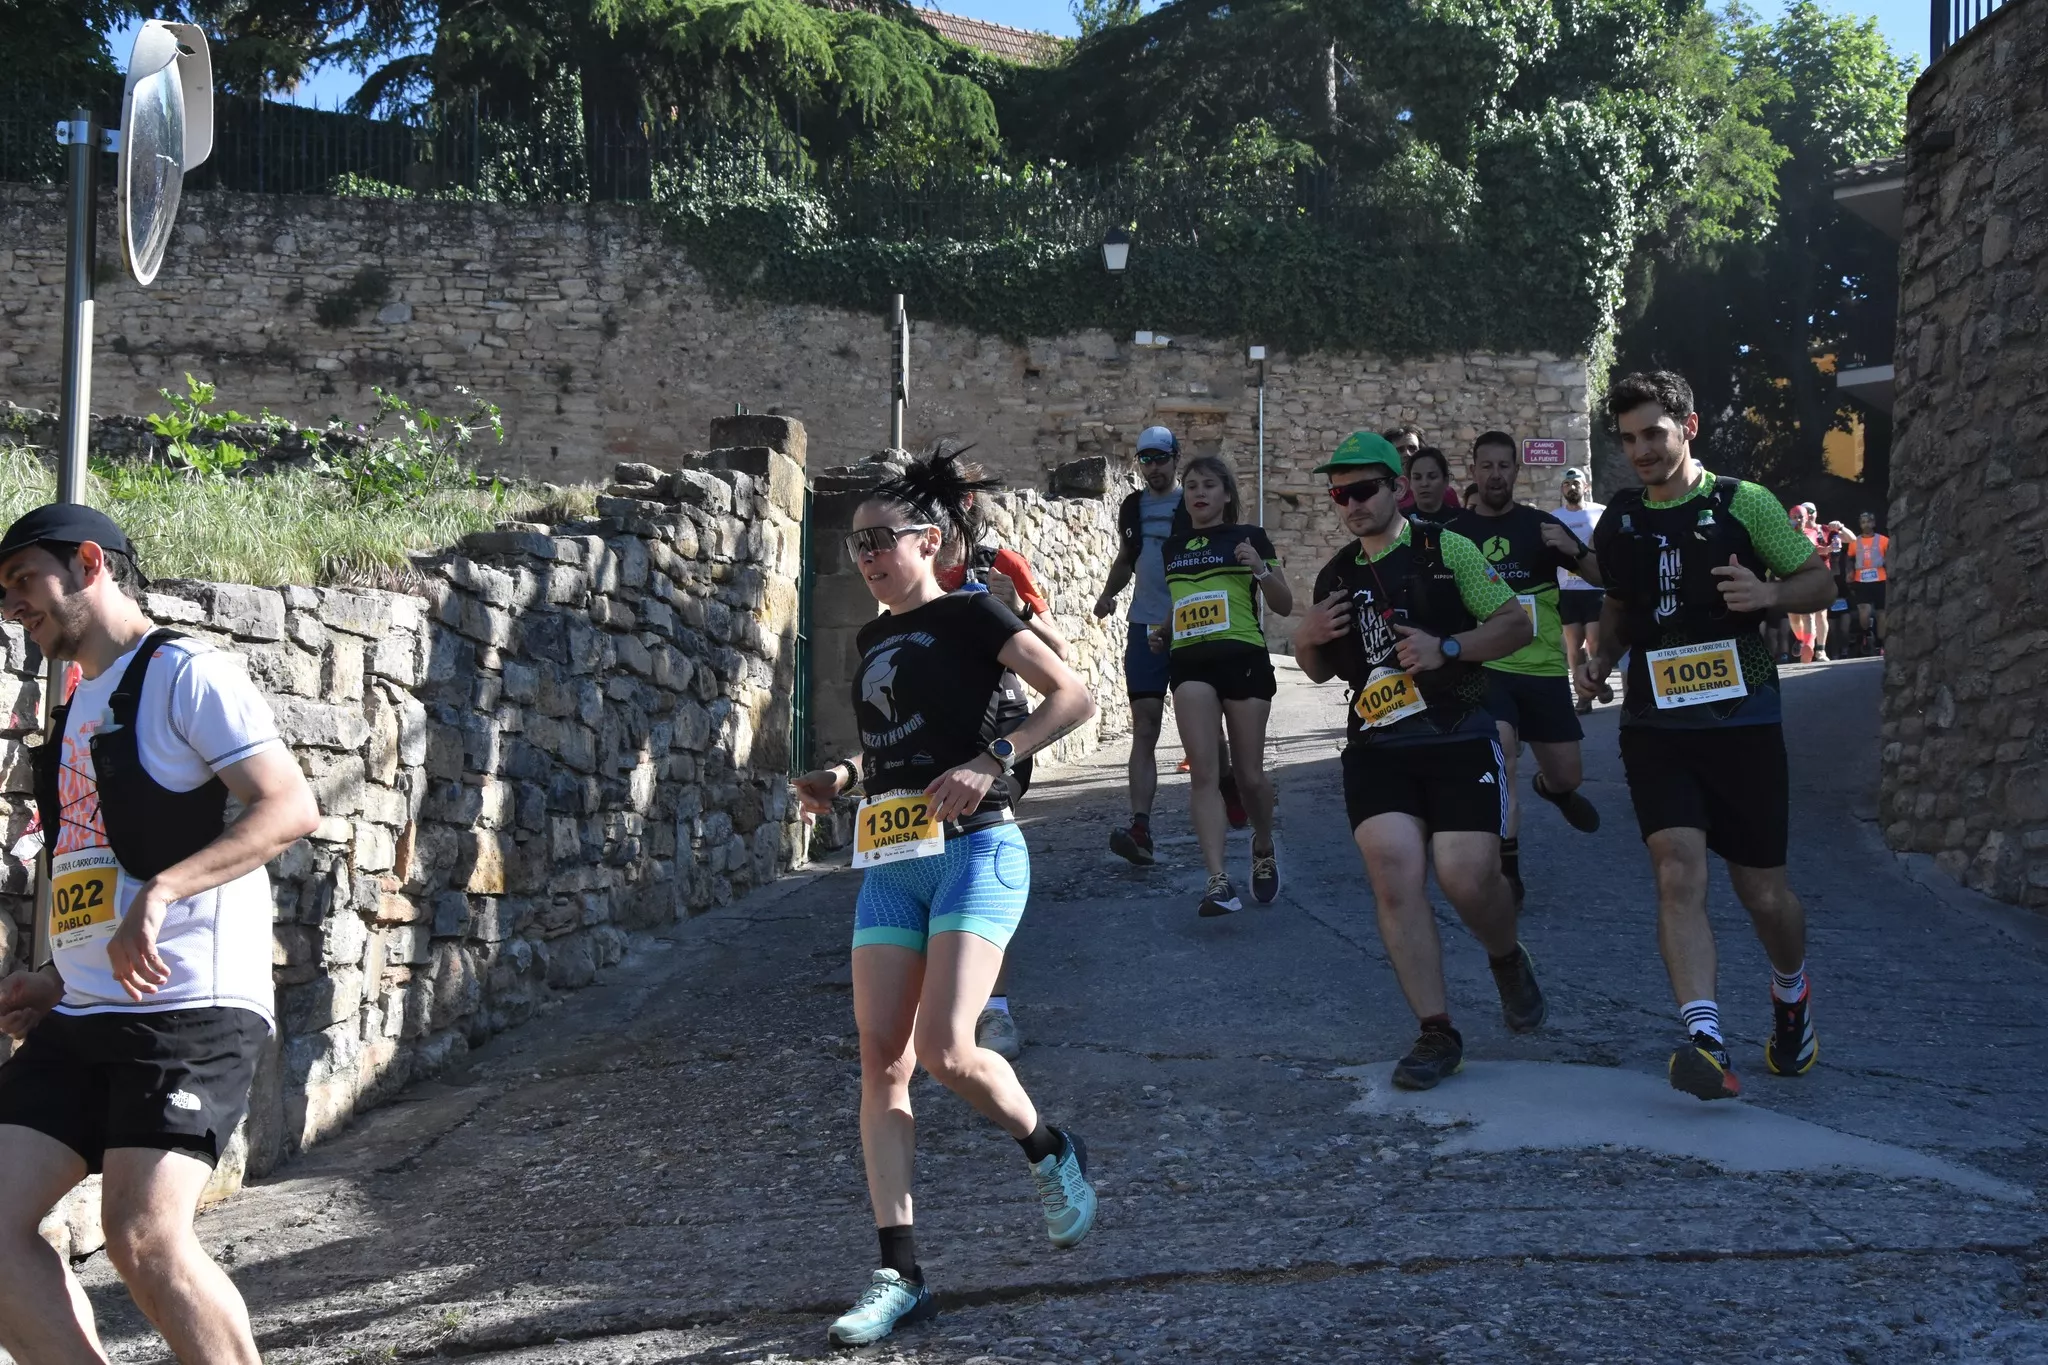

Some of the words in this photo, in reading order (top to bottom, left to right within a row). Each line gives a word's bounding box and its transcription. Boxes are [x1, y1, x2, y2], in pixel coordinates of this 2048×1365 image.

[1183, 551, 1201, 560] RETO
[1202, 549, 1212, 557] DE
[1166, 556, 1224, 571] CORRER.COM
[1508, 562, 1520, 570] DE
[1180, 604, 1219, 623] 1101
[1186, 619, 1214, 629] ESTELA
[1679, 646, 1697, 655] SIERRA
[1698, 641, 1730, 652] CARRODILLA
[1663, 658, 1728, 684] 1005
[1361, 679, 1407, 713] 1004
[1665, 679, 1732, 696] GUILLERMO
[866, 803, 928, 836] 1302
[873, 831, 919, 848] VANESA
[72, 856, 116, 868] CARRODILLA
[58, 914, 91, 933] PABLO
